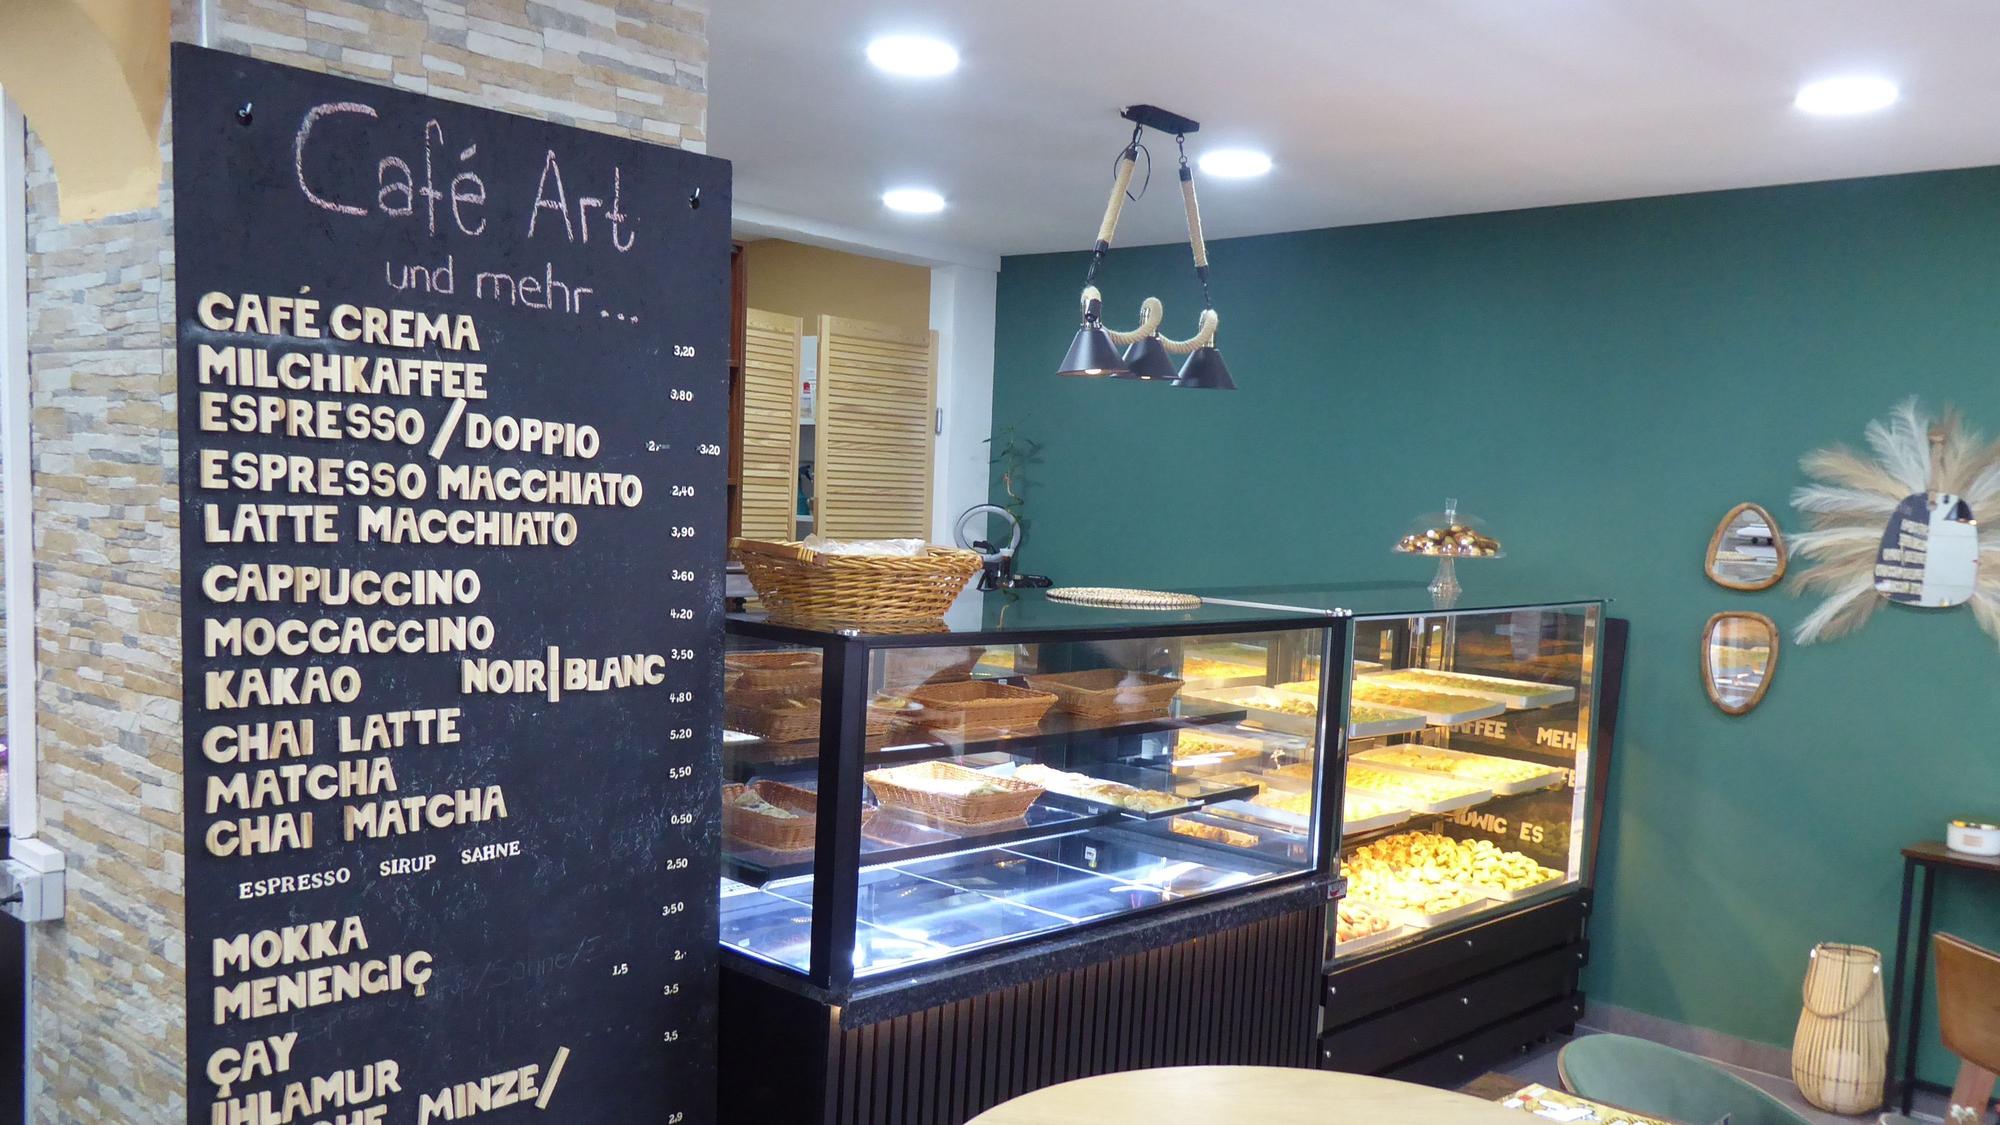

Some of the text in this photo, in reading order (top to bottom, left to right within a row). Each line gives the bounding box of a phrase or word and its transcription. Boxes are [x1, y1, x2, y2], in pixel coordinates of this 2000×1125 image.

[295, 102, 636, 253] Café Art
[385, 254, 455, 295] und
[197, 284, 480, 350] CAFÉ CREMA
[673, 344, 696, 358] 3,20
[198, 345, 488, 400] MILCHKAFFEE
[670, 388, 693, 402] 3,80
[699, 443, 721, 456] 3,20
[201, 449, 642, 507] ESPRESSO MACCHIATO
[671, 484, 695, 497] 2,40
[205, 504, 578, 546] LATTE MACCHIATO
[670, 526, 695, 539] 3,90
[202, 564, 480, 605] CAPPUCCINO
[671, 569, 695, 582] 3,60
[669, 608, 693, 620] 4,20
[205, 616, 494, 657] MOCCACCINO
[670, 648, 694, 661] 3,50
[206, 666, 361, 709] KAKAO
[669, 691, 692, 704] 4,80
[203, 708, 460, 763] CHAI LATTE
[669, 728, 693, 740] 5,20
[1536, 726, 1577, 750] MEH
[669, 765, 692, 780] 5,50
[205, 757, 398, 814] MATCHA
[204, 784, 508, 857] CHAI MATCHA
[670, 812, 693, 825] 0,50
[239, 841, 520, 899] ESPRESSO SIRUP SAHNE
[666, 857, 689, 871] 2,50
[212, 915, 369, 977] MOKKA
[612, 962, 629, 976] 1,5
[212, 950, 434, 1025] MENENGIÇ
[663, 983, 679, 996] 3,5
[663, 1030, 679, 1042] 3,5
[206, 1031, 298, 1099] ÇAY
